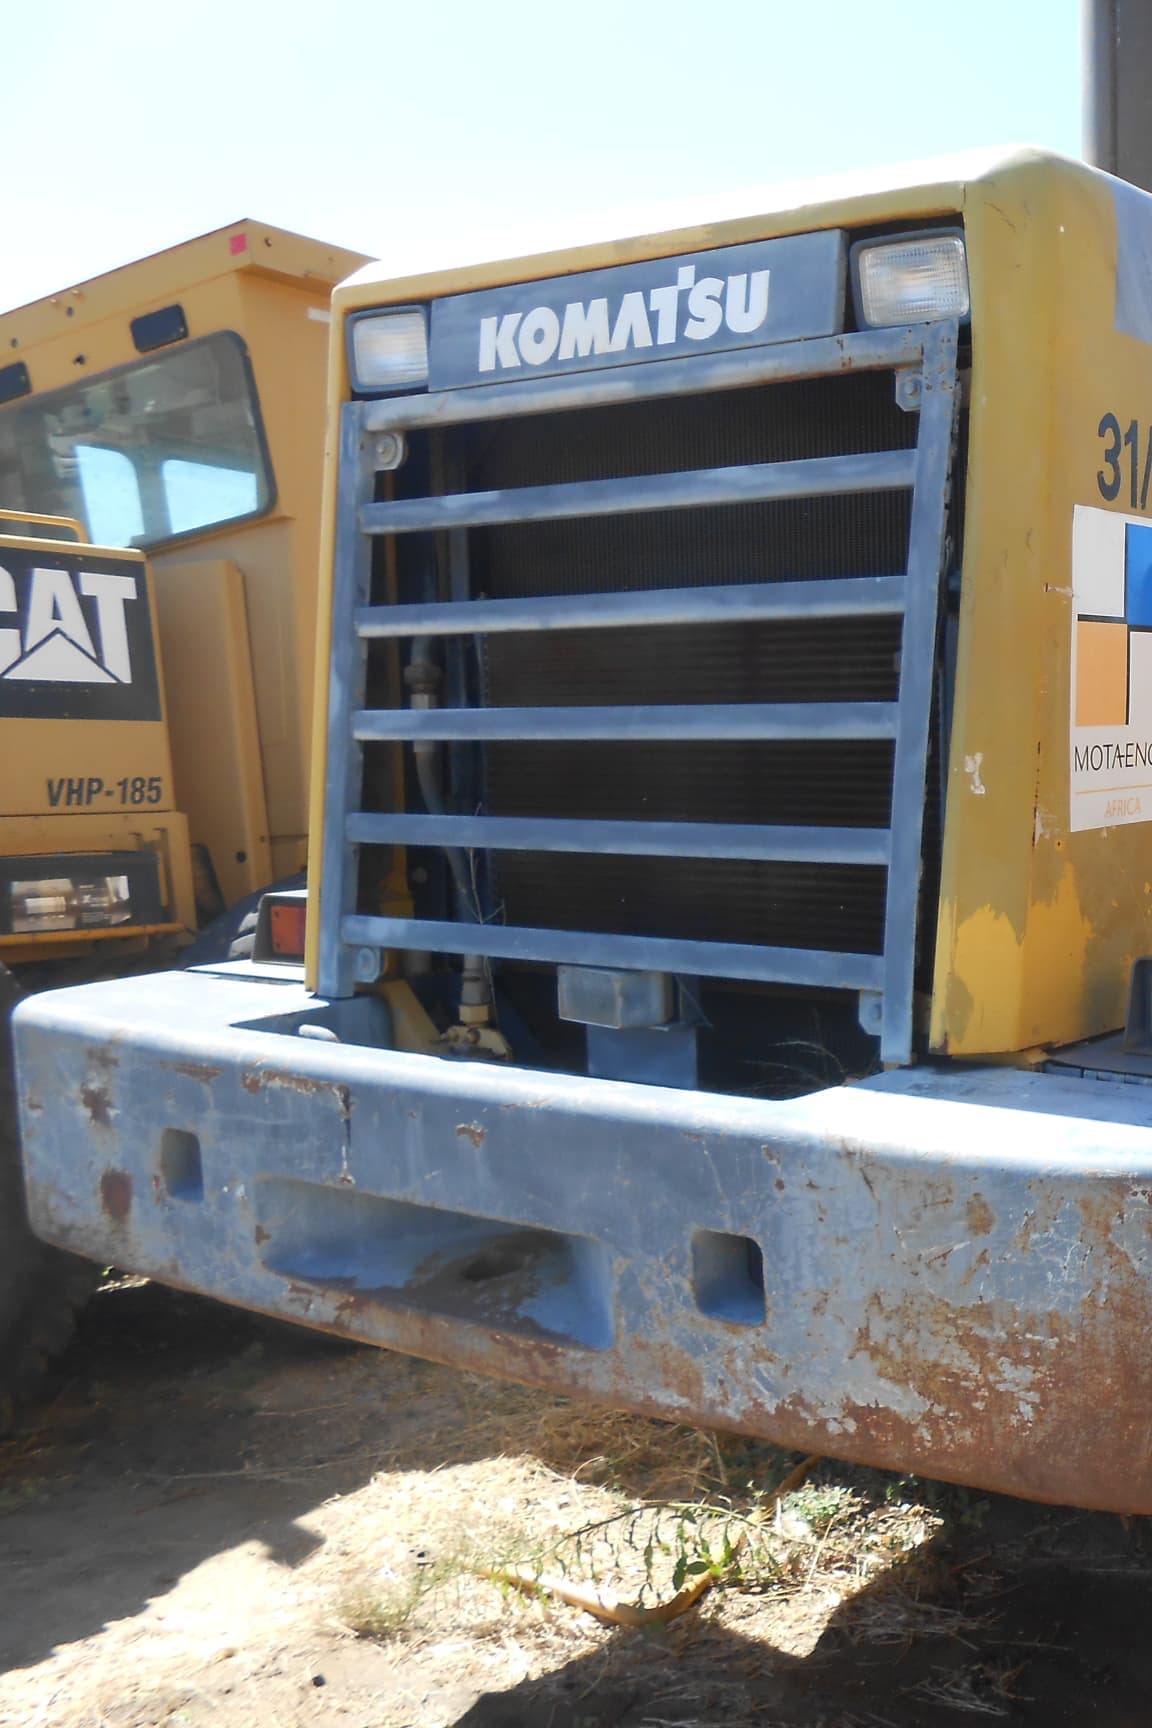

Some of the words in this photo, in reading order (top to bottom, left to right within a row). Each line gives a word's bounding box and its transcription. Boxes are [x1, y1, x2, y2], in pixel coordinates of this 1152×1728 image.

[478, 265, 770, 372] KOMATSU
[47, 776, 163, 807] VHP-185
[1104, 797, 1142, 818] AFRICA
